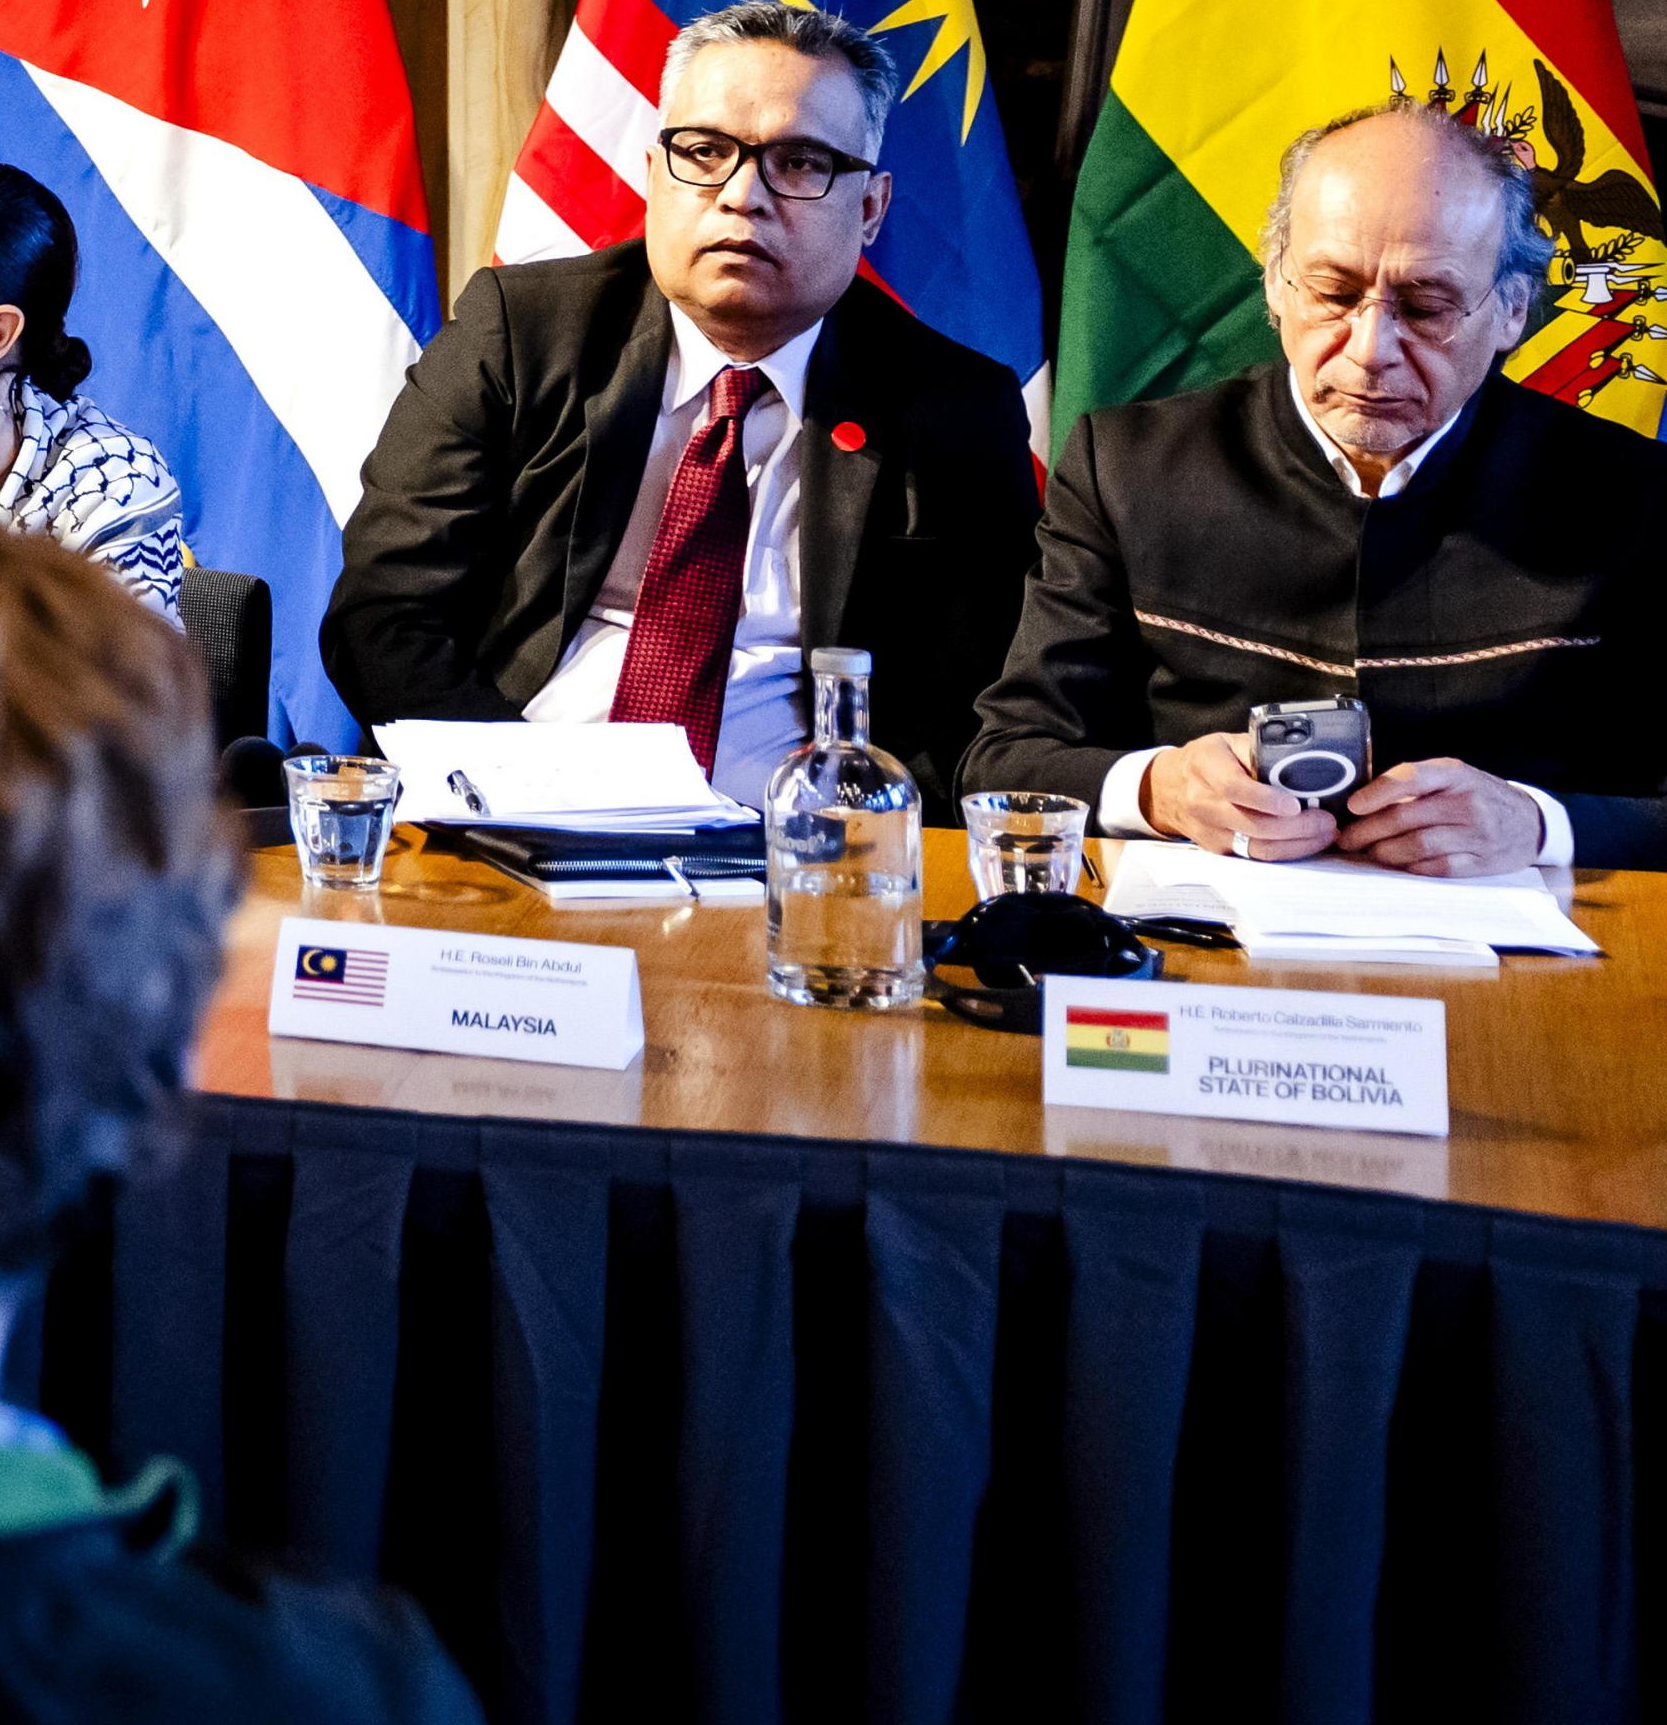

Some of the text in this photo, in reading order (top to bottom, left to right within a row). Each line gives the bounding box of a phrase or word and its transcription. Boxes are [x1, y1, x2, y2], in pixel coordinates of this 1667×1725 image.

[515, 955, 539, 969] Bin
[540, 957, 582, 974] Abdul
[450, 1009, 558, 1037] MALAYSIA
[1210, 1006, 1272, 1024] Roberto
[1208, 1055, 1393, 1086] PLURINATIONAL
[1198, 1076, 1404, 1107] STATE OF BOLIVIA
